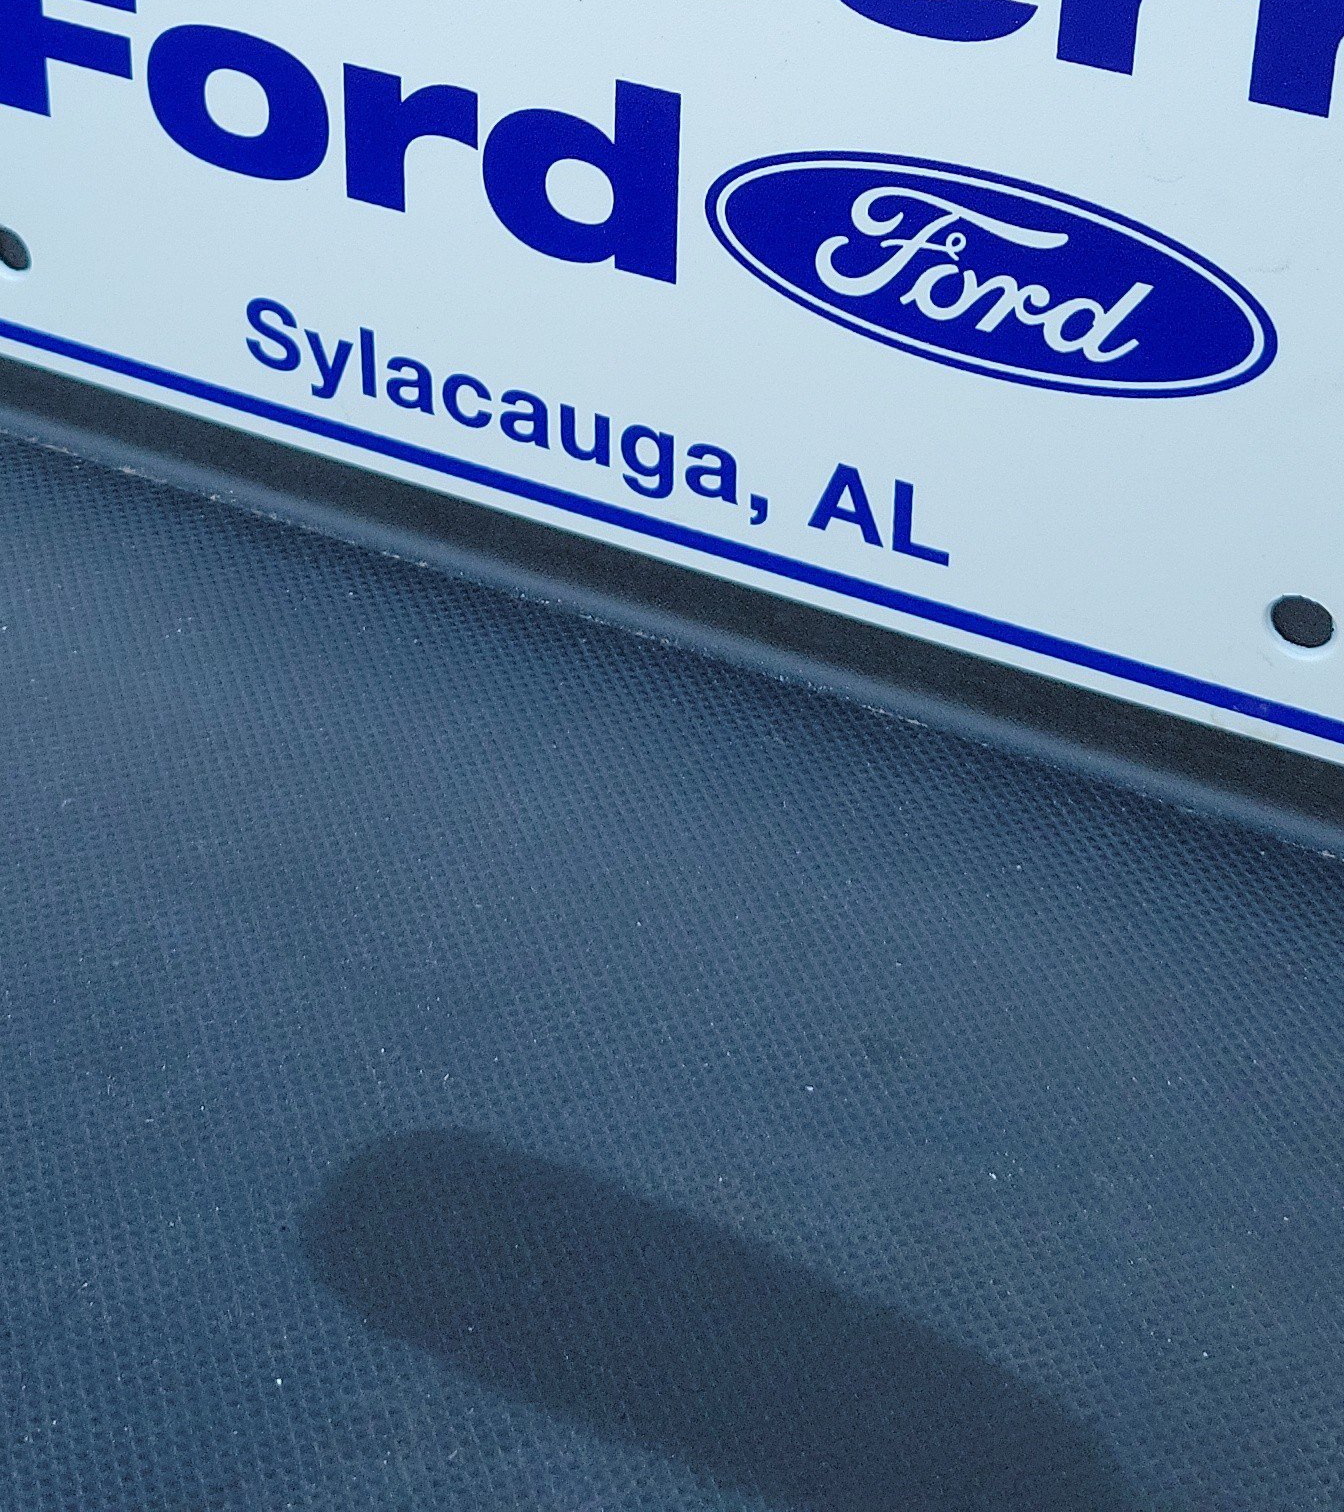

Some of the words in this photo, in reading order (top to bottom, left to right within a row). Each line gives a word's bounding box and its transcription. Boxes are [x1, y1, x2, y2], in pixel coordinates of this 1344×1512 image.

[815, 186, 1154, 364] Ford
[245, 297, 770, 527] Sylacauga,
[807, 462, 950, 567] AL
